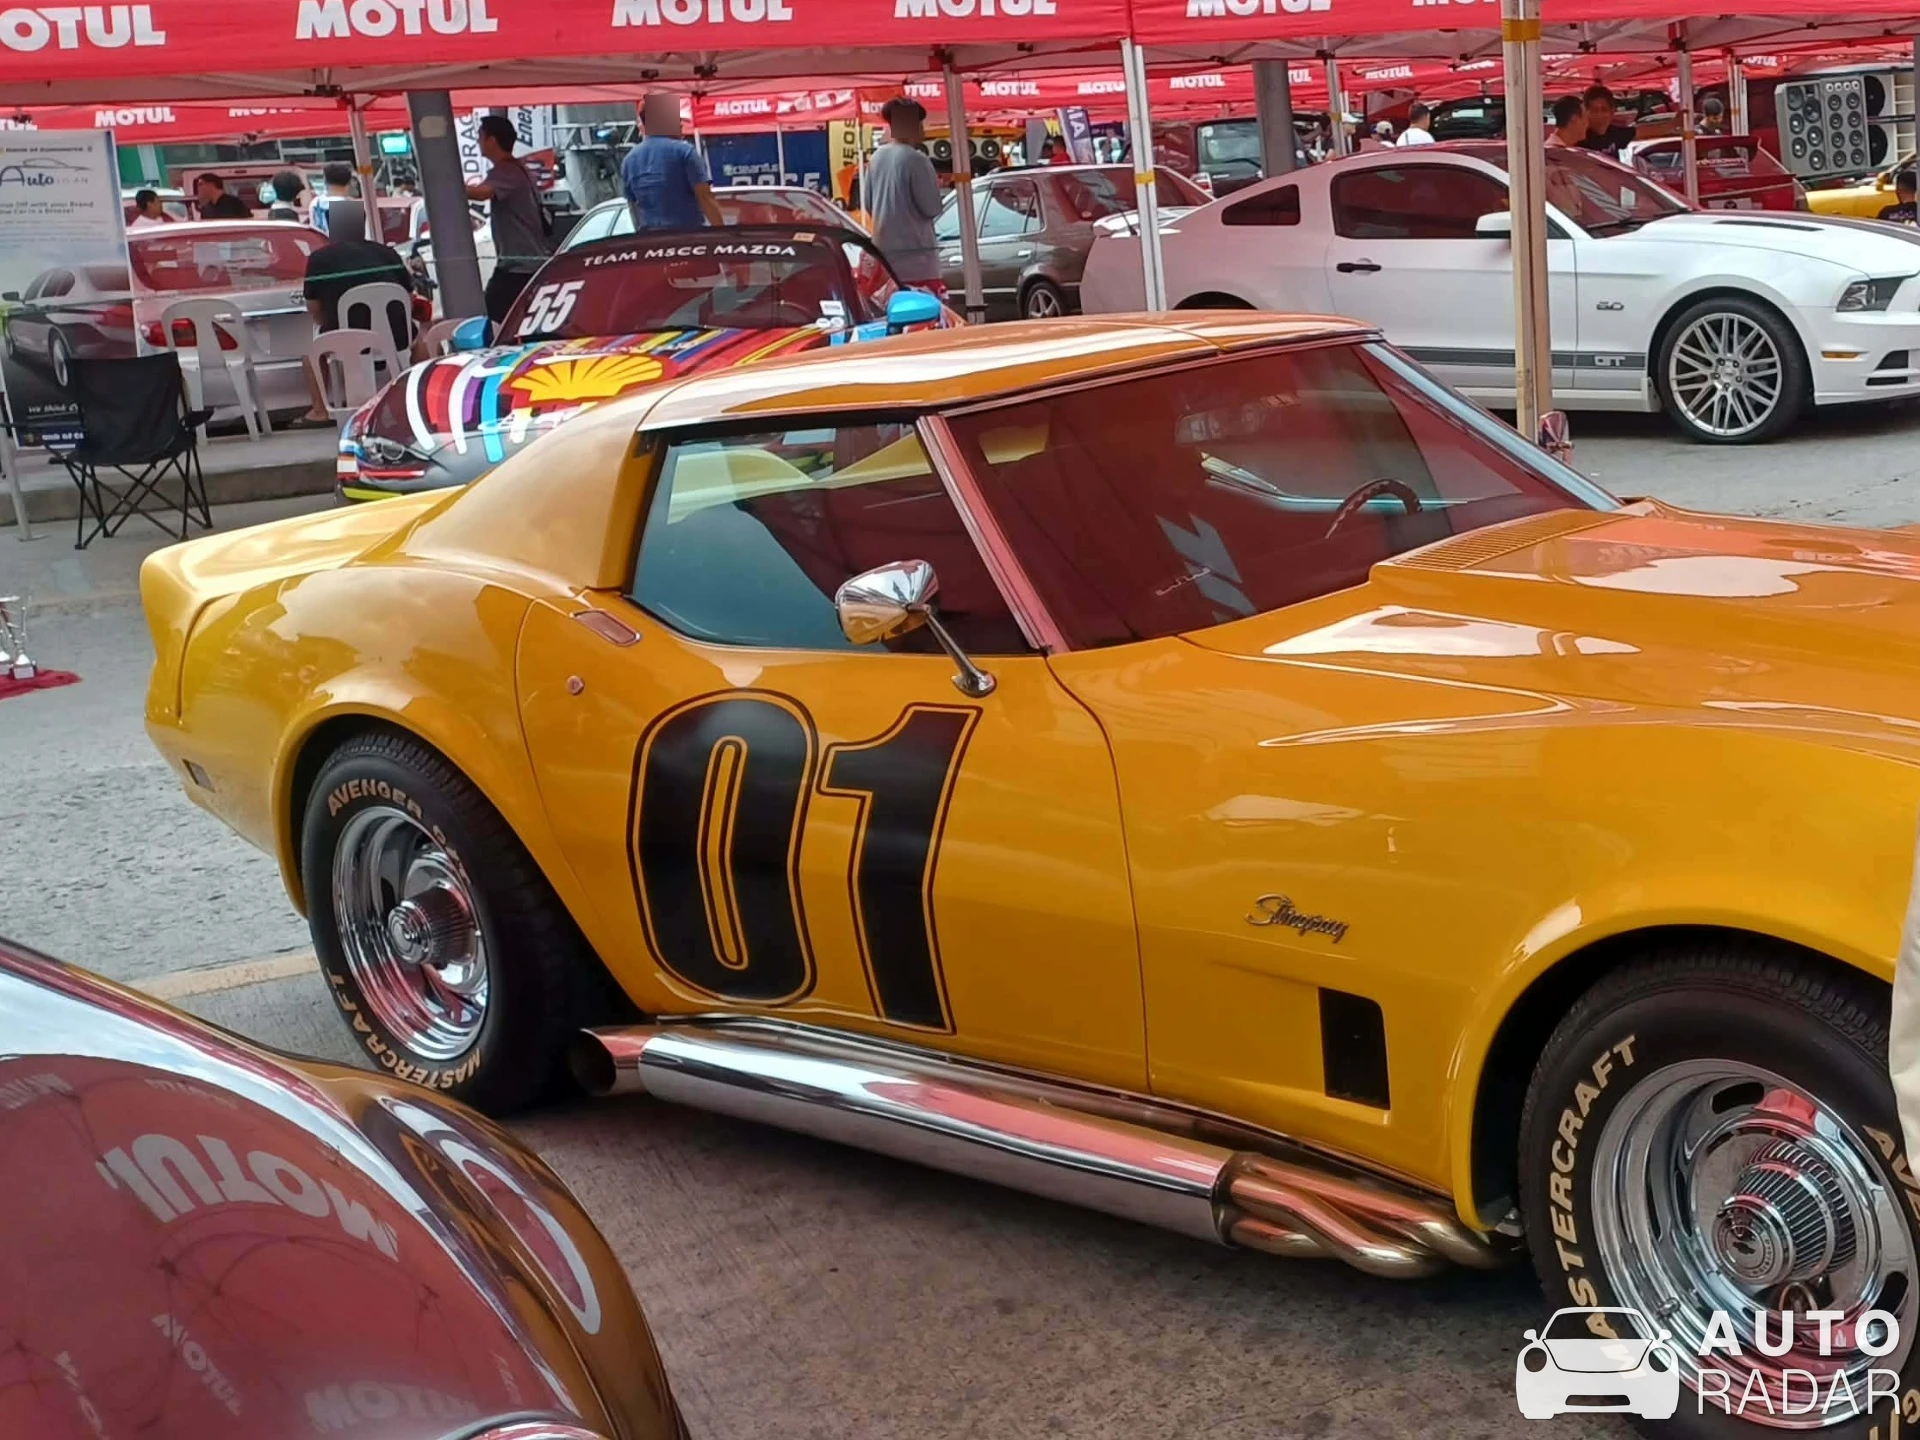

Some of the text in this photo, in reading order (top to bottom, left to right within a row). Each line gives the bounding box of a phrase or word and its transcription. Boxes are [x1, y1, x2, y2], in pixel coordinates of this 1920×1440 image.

[295, 0, 498, 40] MOTUL
[611, 0, 793, 27] MOTUL
[894, 0, 1057, 19] MOTUL
[981, 82, 1040, 96] MOTUL
[1077, 81, 1126, 94] MOTU
[1170, 74, 1225, 89] MOTUL
[95, 107, 175, 128] MOTUL
[714, 98, 772, 116] MOTUL
[584, 250, 638, 267] TEAM
[713, 244, 796, 257] MAZDA
[516, 280, 586, 337] 55
[1594, 355, 1626, 367] GT
[328, 778, 424, 820] AVENGER
[626, 687, 983, 1036] 01
[326, 966, 482, 1090] MASTERCRAFT
